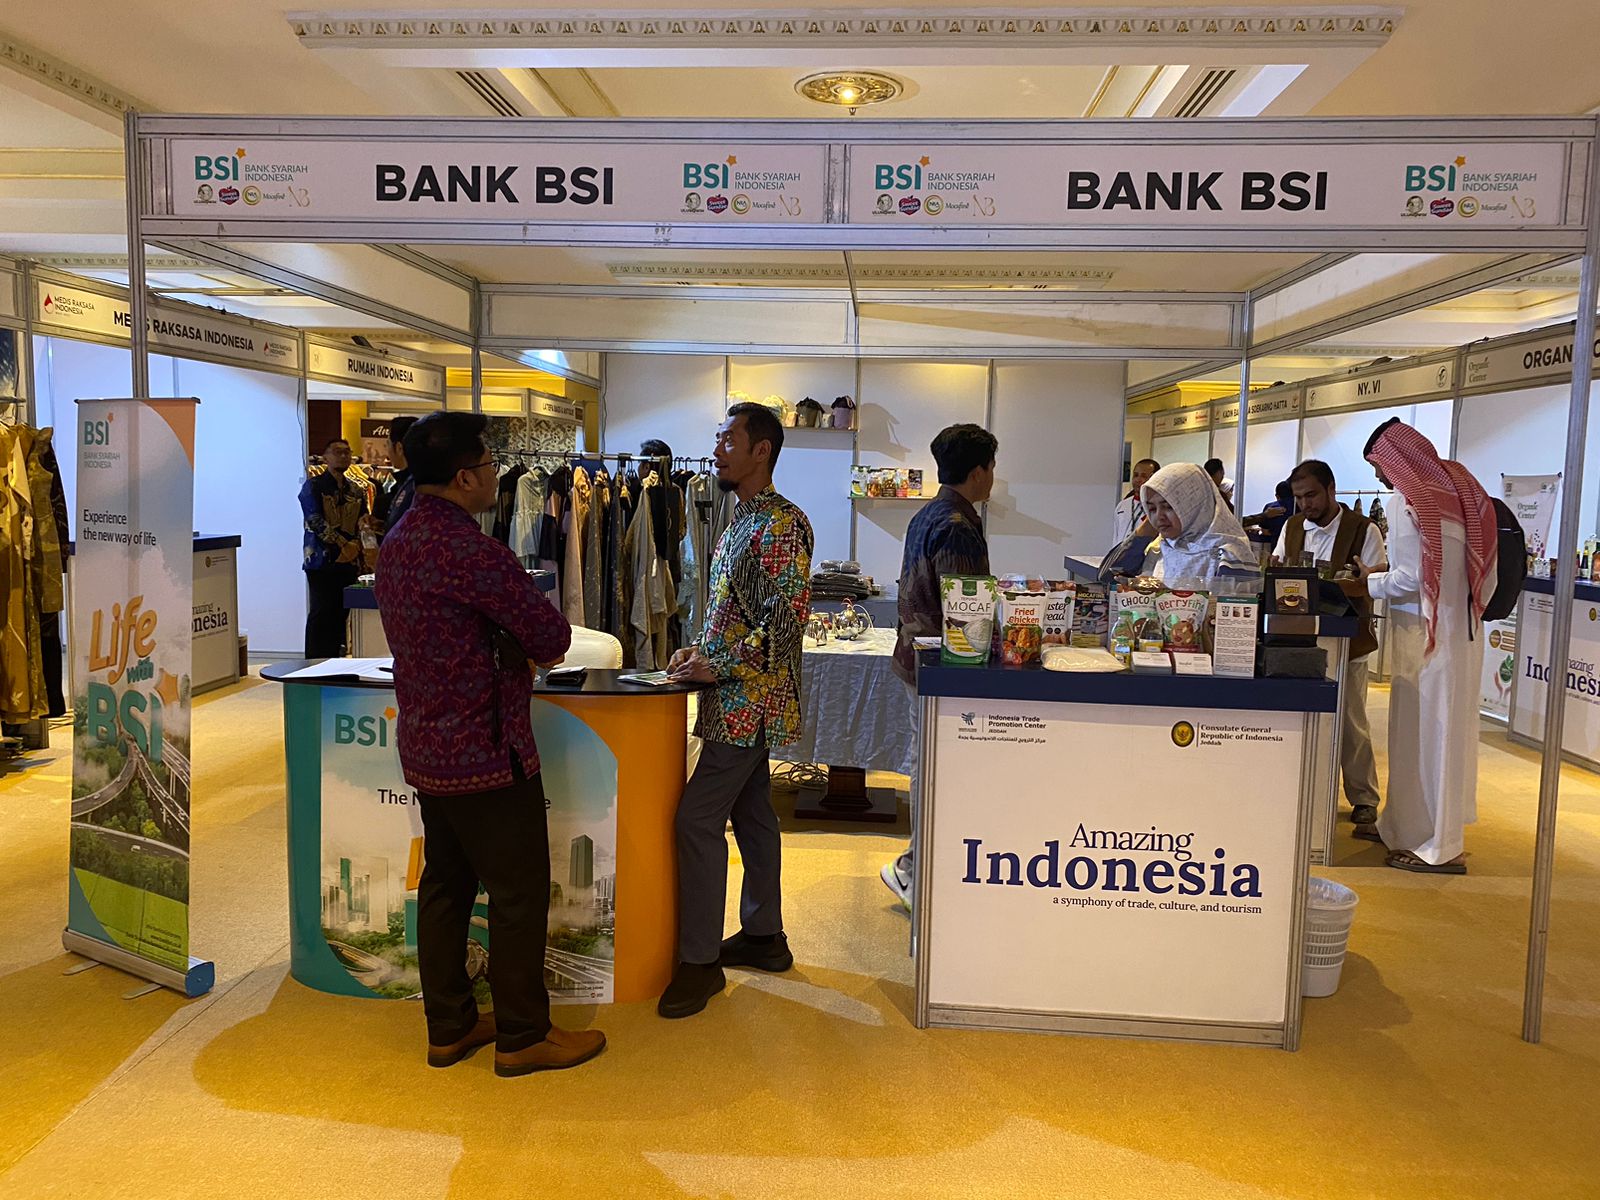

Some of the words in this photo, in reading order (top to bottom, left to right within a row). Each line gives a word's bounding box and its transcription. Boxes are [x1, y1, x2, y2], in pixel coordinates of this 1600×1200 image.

[194, 155, 239, 181] BSI
[244, 164, 269, 173] BANK
[271, 164, 308, 174] SYARIAH
[683, 162, 729, 189] BSI
[244, 173, 294, 182] INDONESIA
[376, 164, 520, 204] BANK
[536, 166, 614, 205] BSI
[734, 180, 786, 190] INDONESIA
[735, 172, 760, 181] BANK
[762, 172, 801, 182] SYARIAH
[875, 164, 922, 190] BSI
[927, 181, 980, 190] INDONESIA
[928, 172, 955, 182] BANK
[956, 172, 995, 182] SYARIAH
[1405, 165, 1457, 192] BSI
[1462, 173, 1492, 182] BANK
[1493, 173, 1537, 182] SYARIAH
[1067, 171, 1224, 210] BANK
[1241, 171, 1328, 211] BSI
[1462, 182, 1519, 192] INDONESIA
[54, 296, 71, 305] MEDIS
[72, 300, 95, 310] RAKSASA
[55, 304, 84, 315] INDONESIA
[153, 319, 202, 341] RAKSASA
[204, 330, 254, 351] INDONESIA
[1523, 344, 1573, 369] ORGAN
[348, 359, 375, 376] RUMAH
[377, 365, 414, 383] INDONESIA
[1357, 383, 1371, 396] NY.
[1373, 379, 1381, 393] VI
[84, 420, 109, 445] BSI
[83, 509, 127, 525] Experience
[83, 527, 97, 540] the
[98, 531, 114, 542] new
[115, 532, 132, 547] way
[133, 531, 143, 545] of
[143, 531, 157, 546] life
[948, 601, 991, 612] MOCAF
[1014, 607, 1035, 615] Fried
[1008, 616, 1040, 624] Chicken
[89, 595, 157, 685] Life
[88, 681, 163, 764] BSI
[335, 713, 387, 747] BSI
[1200, 724, 1240, 732] Consulate
[1241, 725, 1271, 733] General
[1200, 732, 1235, 740] Republic
[1245, 734, 1283, 742] Indonesia
[377, 789, 408, 805] The
[1069, 823, 1194, 862] Amazing
[962, 838, 1262, 898] Indonesia
[1061, 897, 1113, 909] symphony
[1115, 898, 1127, 908] of
[1127, 900, 1157, 910] trade,
[1159, 900, 1199, 912] culture,
[1200, 902, 1219, 912] and
[1222, 904, 1262, 914] tourism
